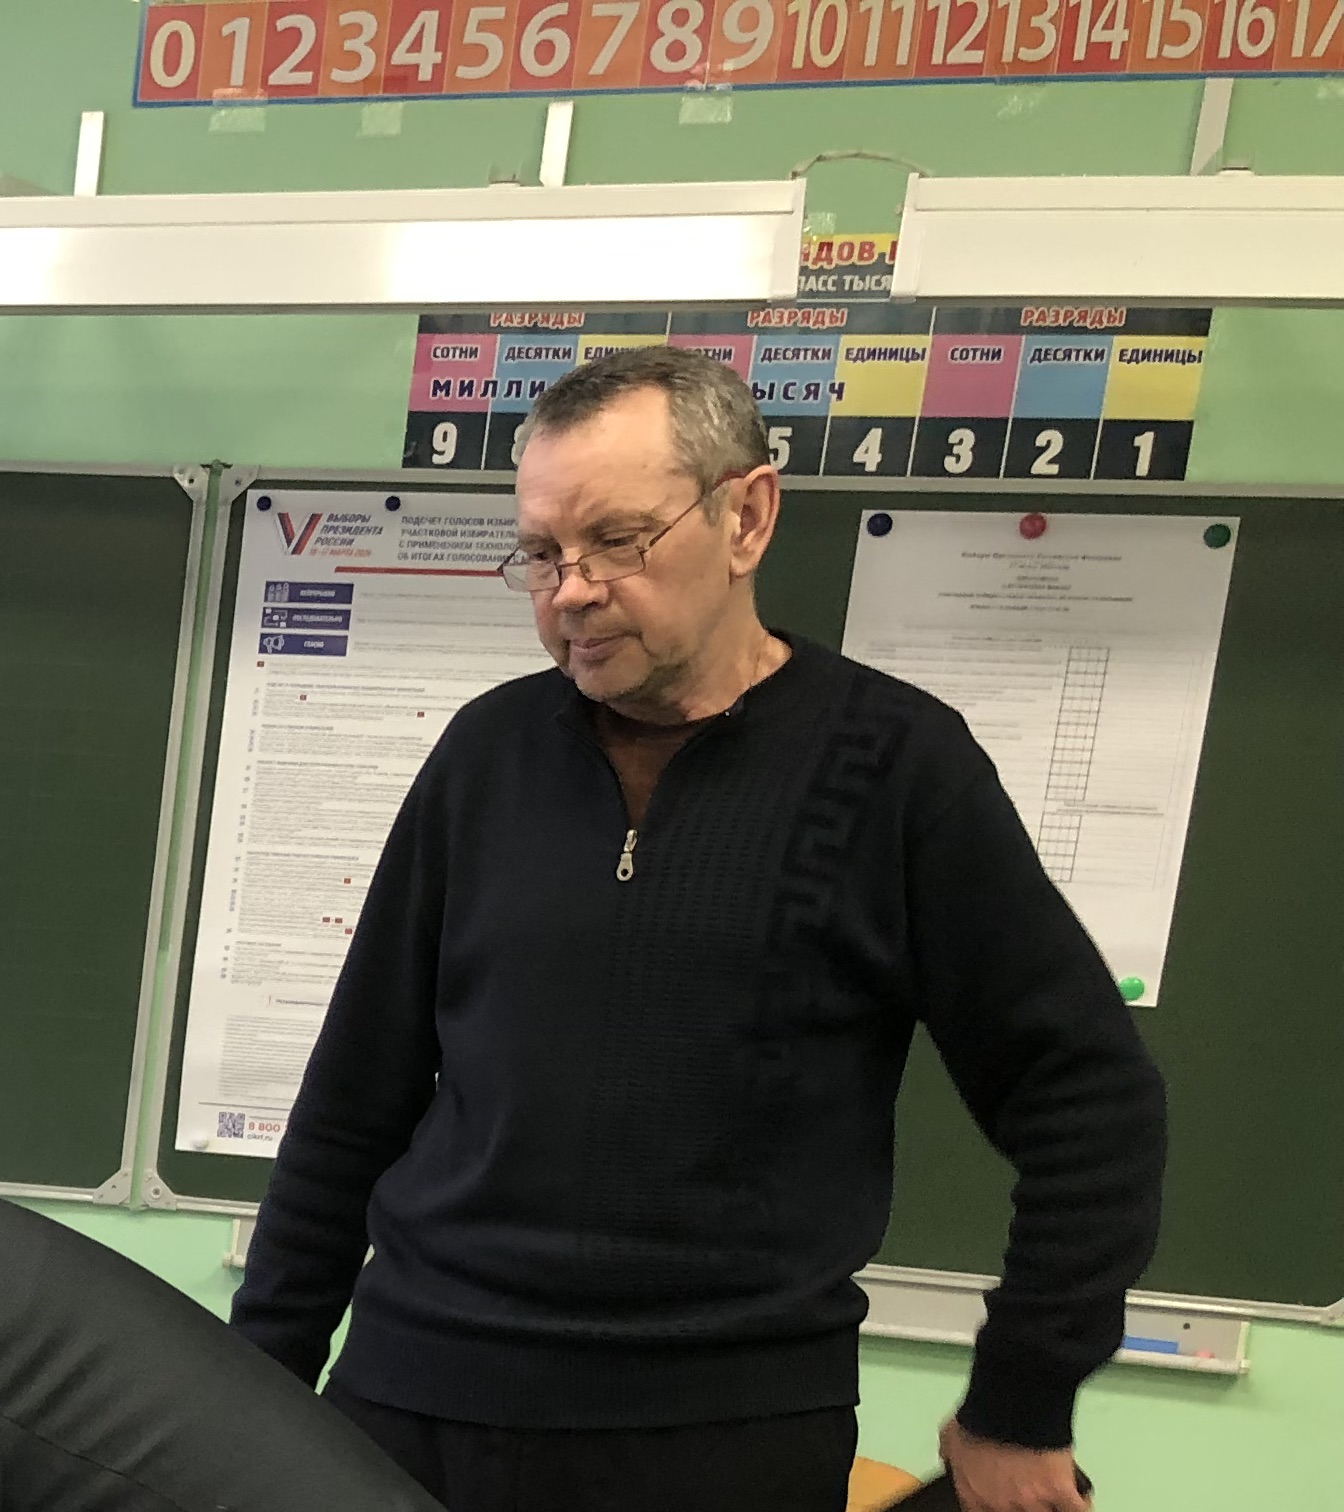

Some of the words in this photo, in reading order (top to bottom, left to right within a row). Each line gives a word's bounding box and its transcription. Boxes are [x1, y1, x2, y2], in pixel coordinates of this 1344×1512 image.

[149, 19, 196, 88] 0
[221, 16, 251, 87] 1
[267, 13, 317, 86] 2
[329, 10, 378, 84] 3
[390, 9, 443, 82] 4
[455, 6, 507, 80] 5
[519, 2, 571, 77] 6
[589, 2, 640, 76] 7
[650, 0, 705, 73] 8
[719, 0, 775, 71] 9
[786, 0, 848, 69] 10
[858, 0, 915, 67] 11
[926, 0, 990, 65] 12
[998, 0, 1059, 63] 13
[1063, 0, 1129, 62] 14
[1141, 0, 1203, 60] 15
[1214, 0, 1276, 59] 16
[798, 275, 838, 291] ЛАСС
[843, 275, 893, 291] ТЫСЯ
[489, 312, 584, 328] РАЗРЯДЫ
[748, 309, 847, 328] РАЗРЯДЫ
[1021, 308, 1126, 328] РАЗРЯДЫ
[432, 346, 479, 360] СОТНИ
[504, 346, 573, 361] ДЕСЯТКИ
[761, 347, 833, 363] ДЕСЯТКИ
[845, 347, 927, 363] ЕДИНИЦЫ
[949, 347, 1002, 361] СОТНИ
[1029, 347, 1105, 363] ДЕСЯТКИ
[1118, 348, 1203, 364] ЕДИНИЦЫ
[431, 379, 546, 398] МИЛЛИ
[752, 381, 845, 402] ЫСЯЧ
[432, 422, 457, 465] 9
[768, 426, 793, 471] 5
[853, 427, 882, 472] 4
[944, 428, 976, 474] 3
[1030, 429, 1064, 475] 2
[1133, 431, 1155, 477] 1
[326, 513, 371, 523] ВЫБОРЫ
[320, 524, 384, 536] ПРЕЗИДЕНТА
[314, 536, 355, 546] РОССИИ
